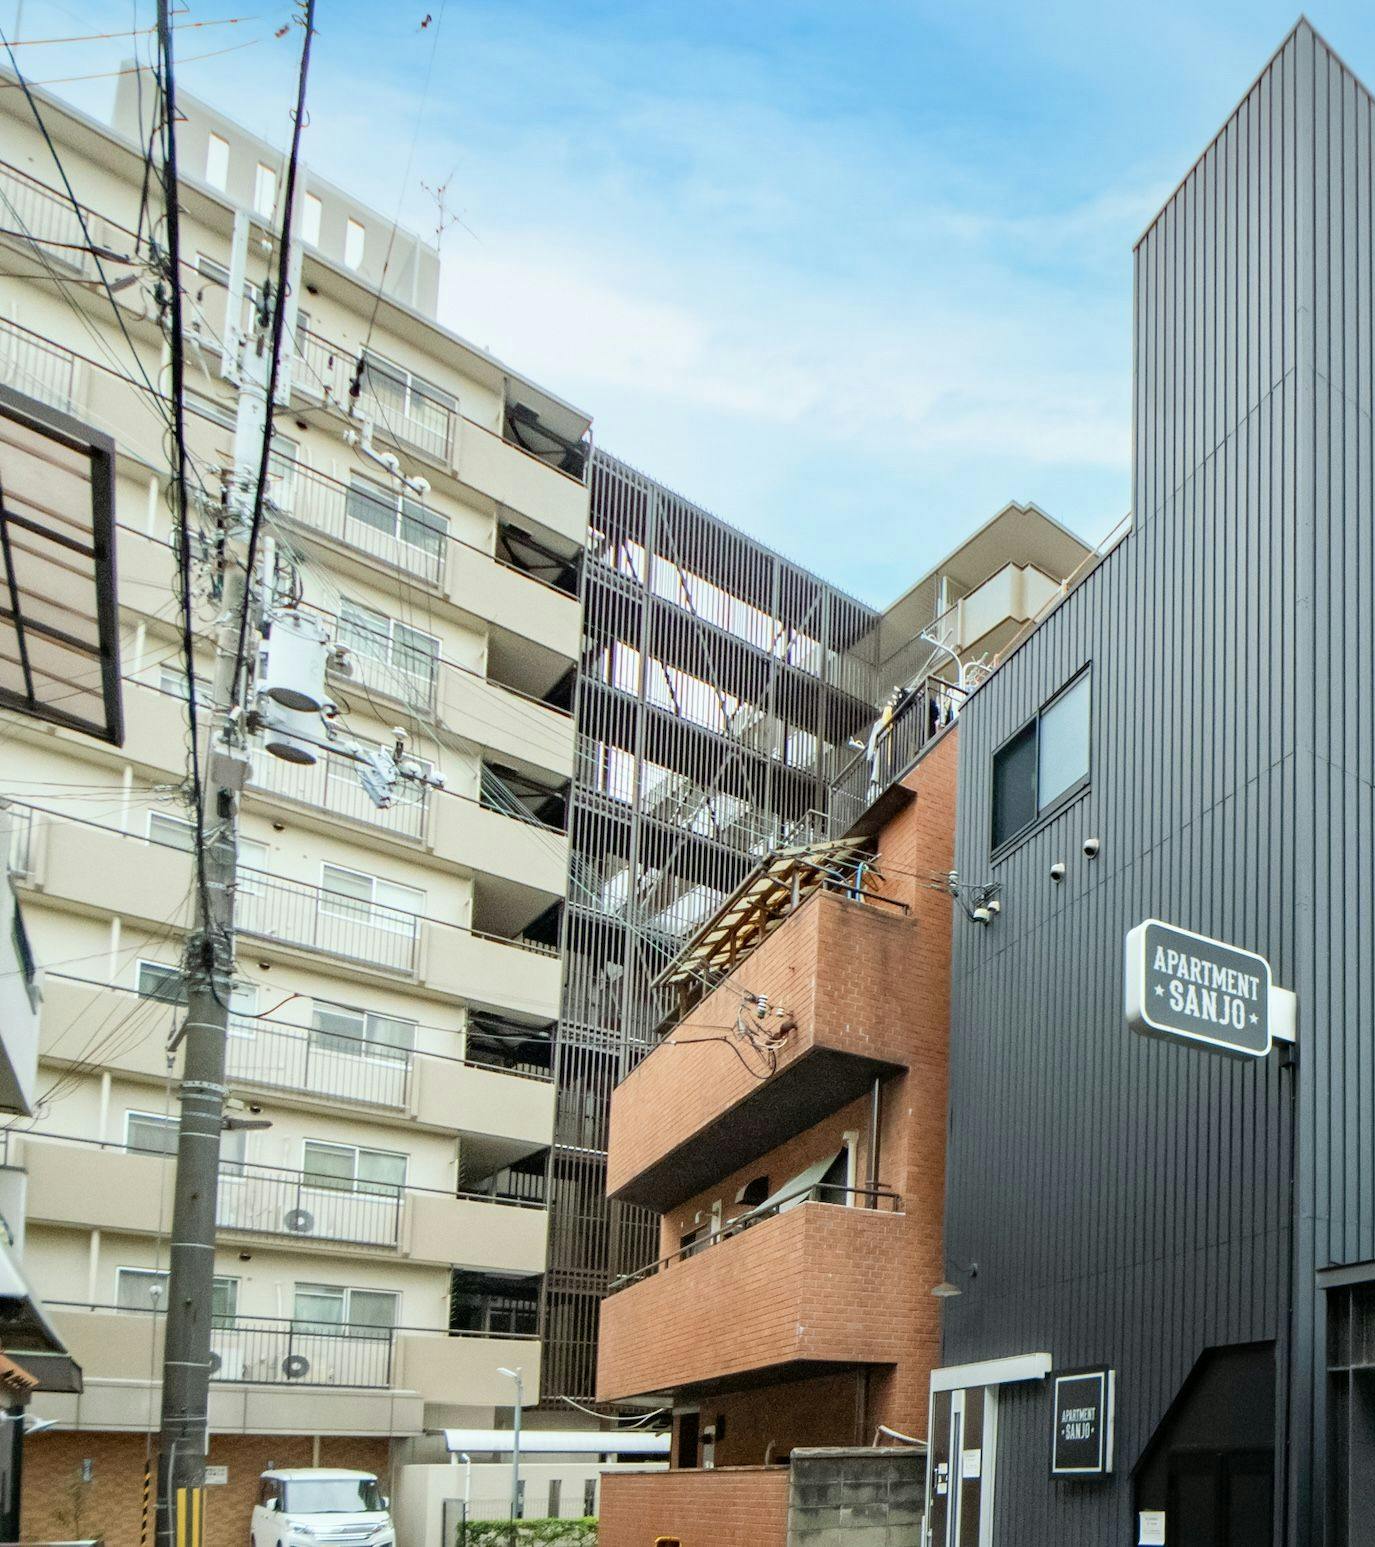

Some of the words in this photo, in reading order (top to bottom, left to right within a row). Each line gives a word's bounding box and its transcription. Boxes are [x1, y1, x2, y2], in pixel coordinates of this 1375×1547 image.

[1154, 946, 1260, 1001] APARTMENT
[1169, 979, 1246, 1030] SANJO
[1061, 1407, 1096, 1422] APARTMENT
[1065, 1422, 1090, 1440] SANJO
